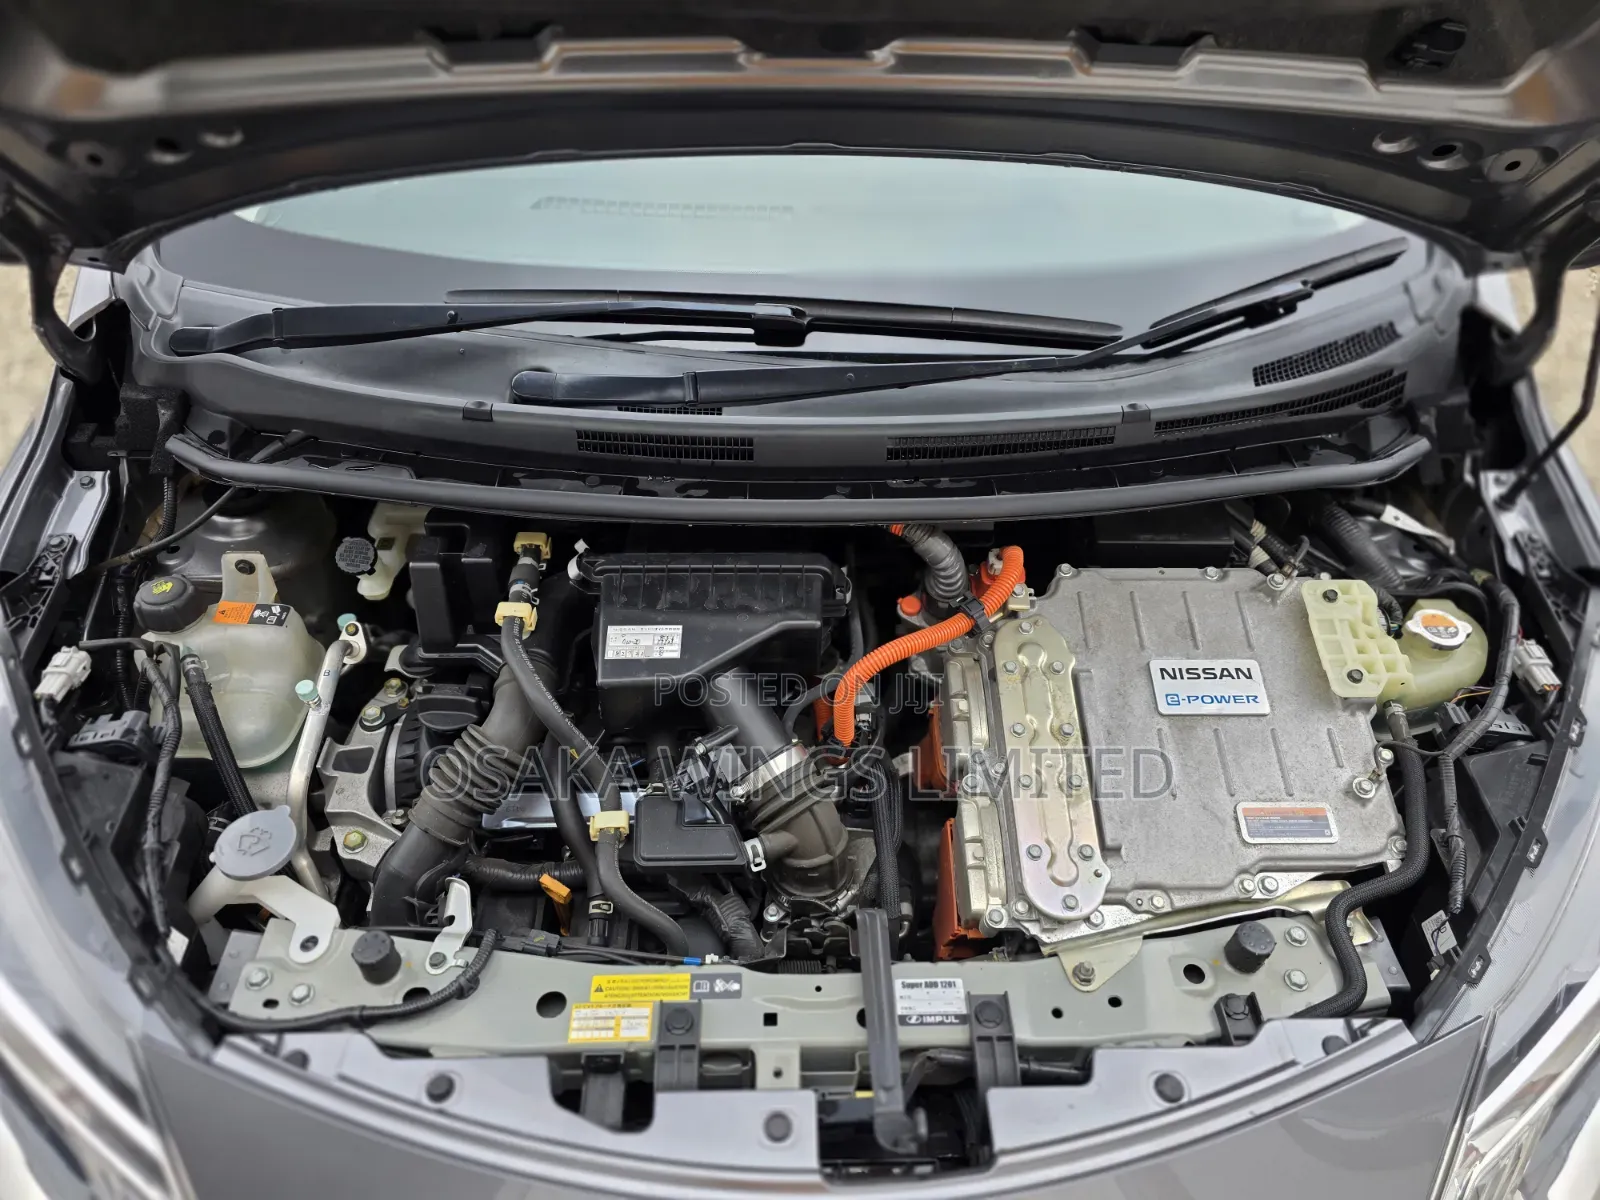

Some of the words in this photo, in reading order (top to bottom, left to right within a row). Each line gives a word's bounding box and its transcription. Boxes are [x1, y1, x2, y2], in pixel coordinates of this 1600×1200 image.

[1159, 667, 1253, 680] NISSAN
[1165, 693, 1260, 706] e-POWER
[901, 980, 923, 990] Super
[923, 1015, 960, 1024] IMPUL
